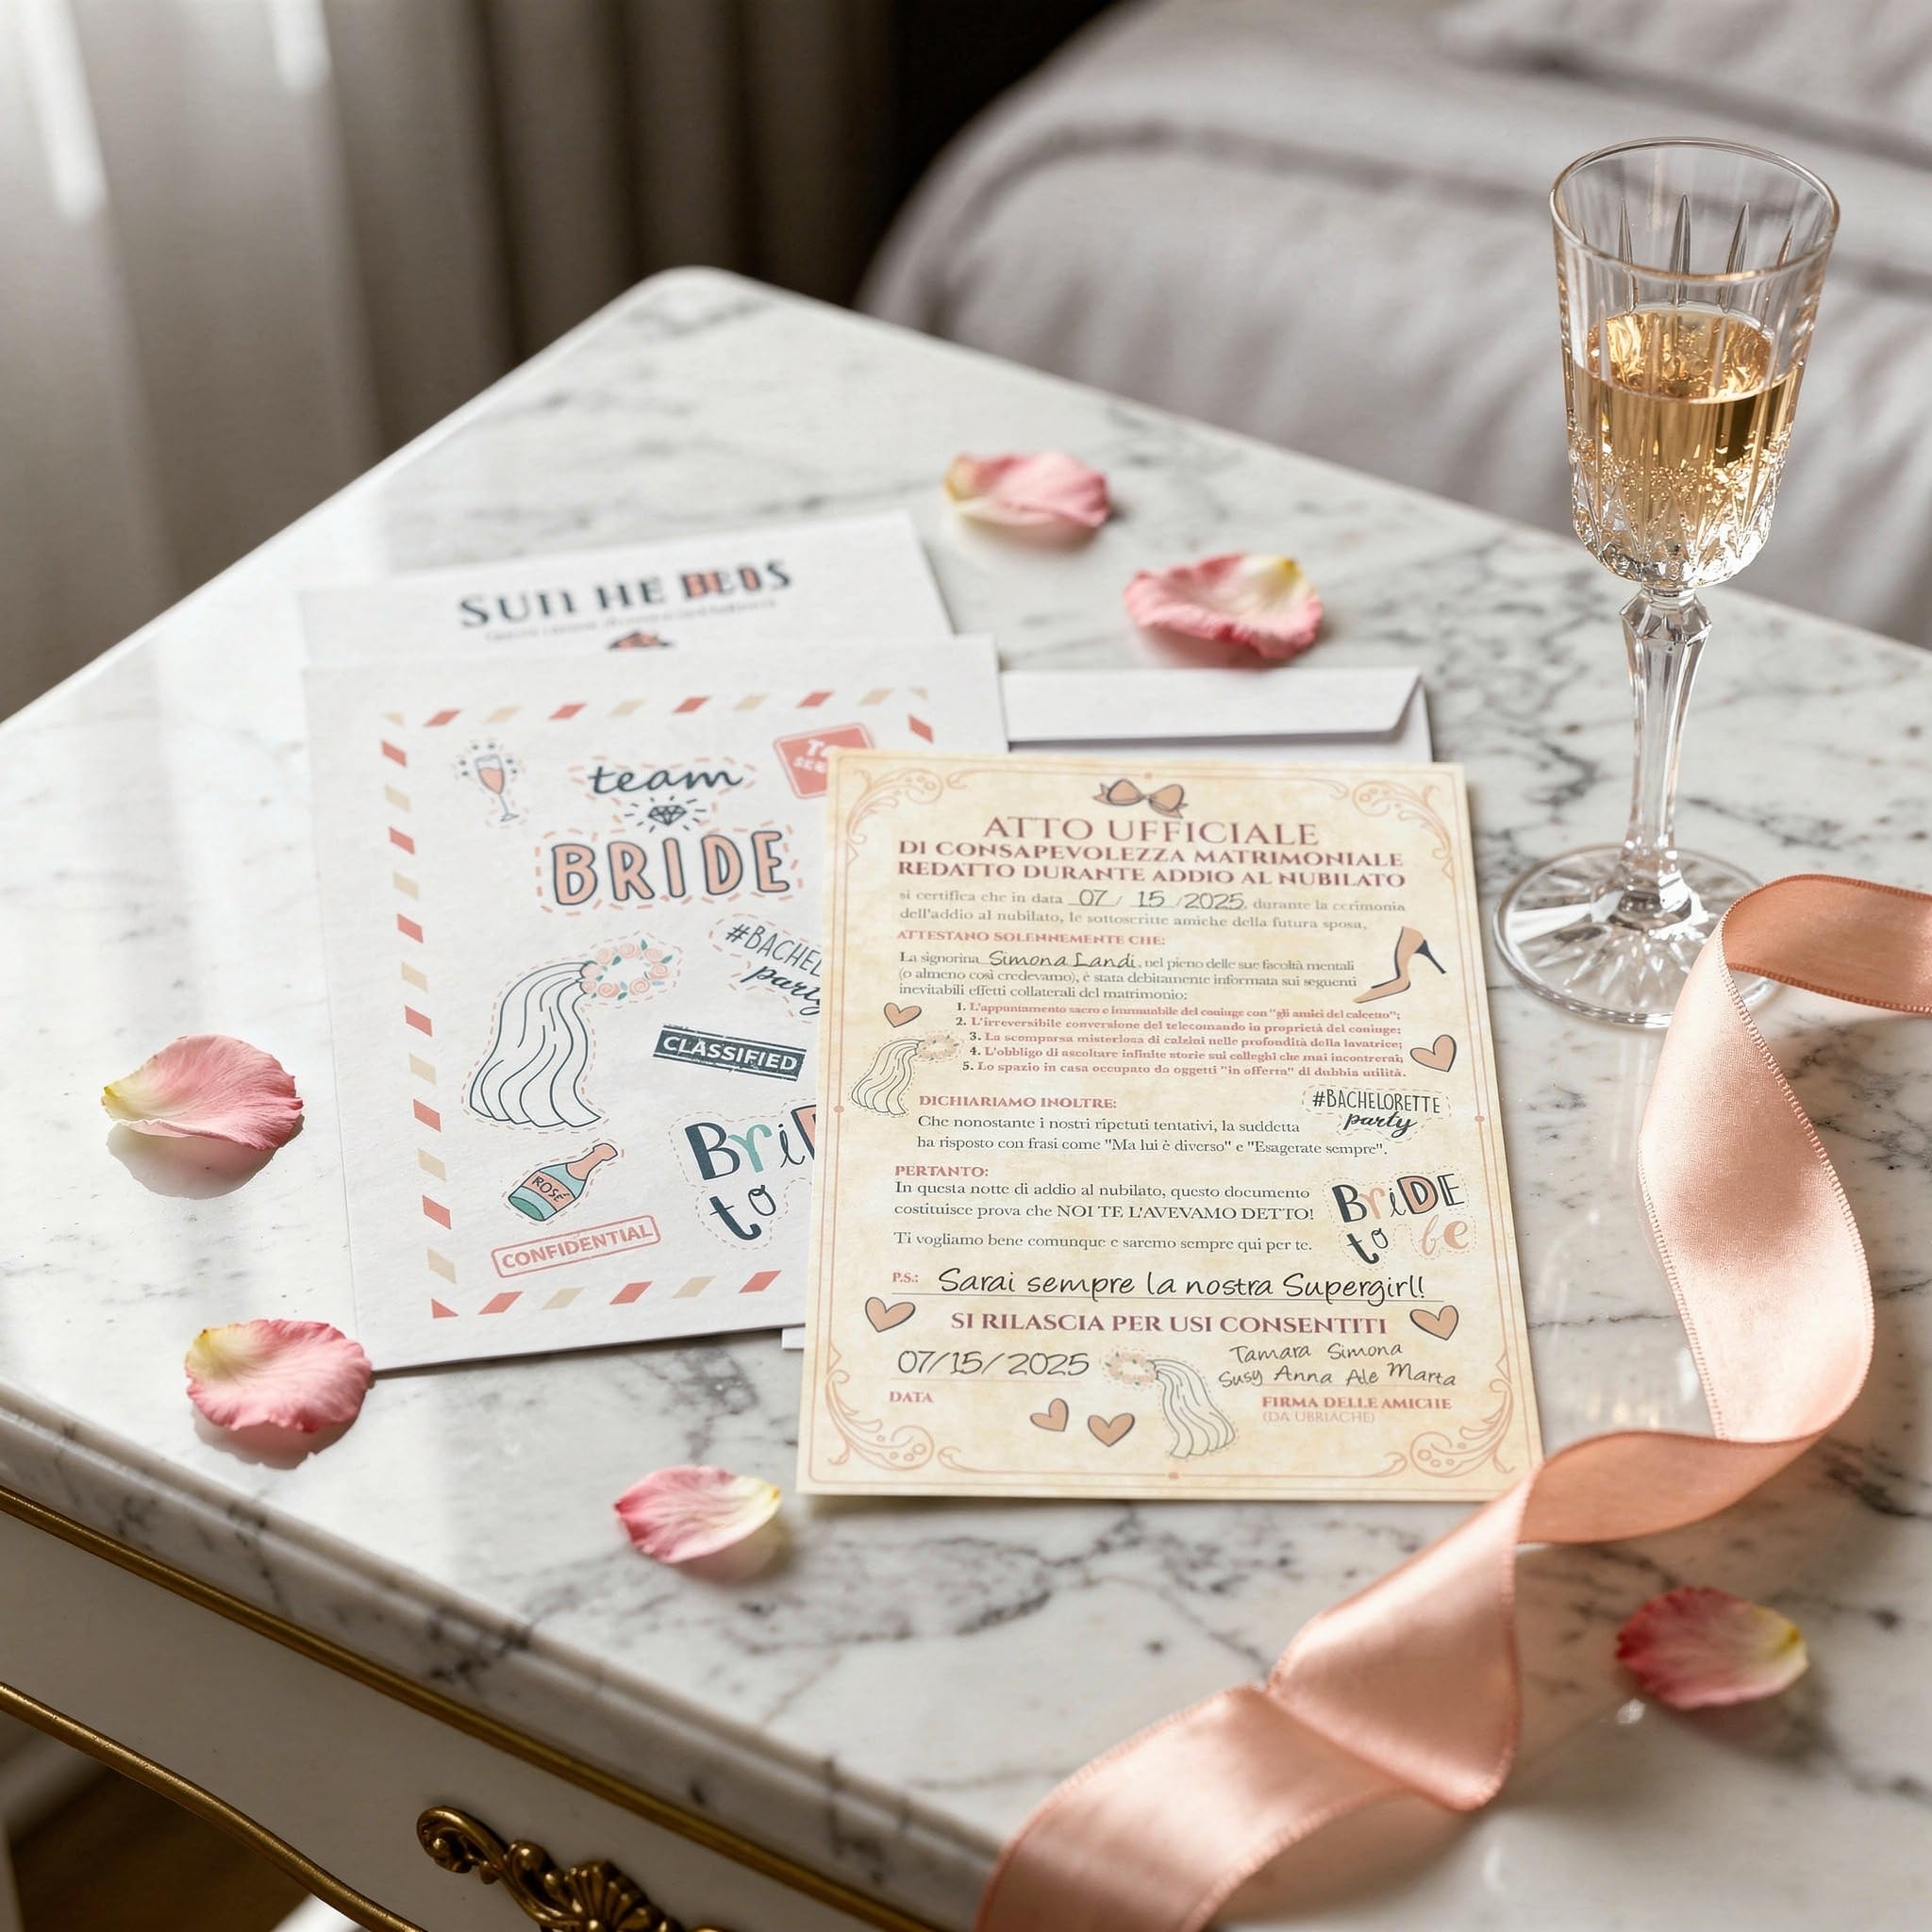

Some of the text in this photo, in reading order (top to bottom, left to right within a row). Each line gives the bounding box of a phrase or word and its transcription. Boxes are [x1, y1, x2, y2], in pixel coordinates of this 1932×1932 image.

[588, 765, 744, 795] team
[983, 816, 1319, 846] ATTO UFFICIALE
[899, 840, 1403, 867] DI CONSAPEVOLEZZA MATRIMONIALE
[551, 829, 791, 907] BRIDE
[898, 860, 1406, 887] REDATTO DURANTE ADDIO AL NUBILATO
[915, 890, 976, 902] certifica
[980, 891, 1008, 903] che
[1011, 891, 1026, 904] in
[1031, 892, 1064, 905] data
[1078, 889, 1108, 907] 07
[1137, 890, 1166, 908] 15
[1252, 897, 1310, 910] durante
[1314, 898, 1328, 910] la
[1332, 900, 1407, 912] cerimonia
[899, 907, 1368, 932] dell'addio al nubilato, le amiche della futura sposa,
[896, 929, 1166, 946] ATTESTANO SOLENNEMENTE CHE:
[724, 923, 823, 977] #BACHEL
[899, 951, 918, 963] La
[921, 951, 982, 966] signorina
[989, 950, 1067, 967] Simona
[1166, 956, 1205, 972] pieno
[1205, 958, 1237, 970] delle
[1261, 958, 1304, 971] facoltà
[898, 967, 912, 981] (o
[914, 967, 967, 980] almeno
[996, 969, 1080, 984] credevamo),
[1126, 971, 1210, 985] debitamente
[1213, 974, 1279, 987] informata
[1303, 975, 1357, 990] seguenti
[898, 982, 1188, 1001] inevitabili effetti collaterali del matrimonio:
[662, 1036, 798, 1074] CLASSIFIED
[919, 1095, 1117, 1109] DICHIARIAMO INOLTRE:
[1312, 1089, 1441, 1114] #BACHELORETTE
[917, 1114, 1301, 1134] Che nonostante nostri ripetuti tentativi, la suddetta
[1342, 1110, 1419, 1140] party
[917, 1135, 1388, 1158] ha risposto con frasi come "Ma lui diverso" "Esagerate sempre".
[894, 1165, 989, 1178] PERTANTO:
[531, 1175, 571, 1203] ROSÉ
[895, 1180, 1310, 1201] In questa notte di addio al nubilato, questo documento
[709, 1183, 777, 1241] to
[893, 1202, 1314, 1221] costituisce prova che NOI TE L'AVEVAMO DETTO!
[502, 1224, 654, 1270] CONFIDENTIAL
[893, 1231, 1312, 1255] Ti vogliamo bene comunque saremo sempre qui per te.
[1346, 1214, 1469, 1265] to be
[938, 1267, 1016, 1293] Sarai
[1027, 1272, 1136, 1303] sempre
[1147, 1271, 1177, 1295] la
[1185, 1276, 1274, 1297] nostra
[1282, 1272, 1425, 1308] Supergirl!
[951, 1312, 1387, 1335] SI RILASCIA PER USI CONSENTITI
[897, 1350, 1090, 1376] 07/15/2025
[1229, 1341, 1403, 1364] Tamara Simona
[1218, 1361, 1457, 1390] Susy Anna Ale Marta
[889, 1391, 934, 1404] DATA
[1261, 1395, 1452, 1409] FIRMA DELLE AMICHE
[1262, 1411, 1376, 1425] (DA UBRIACHE)
